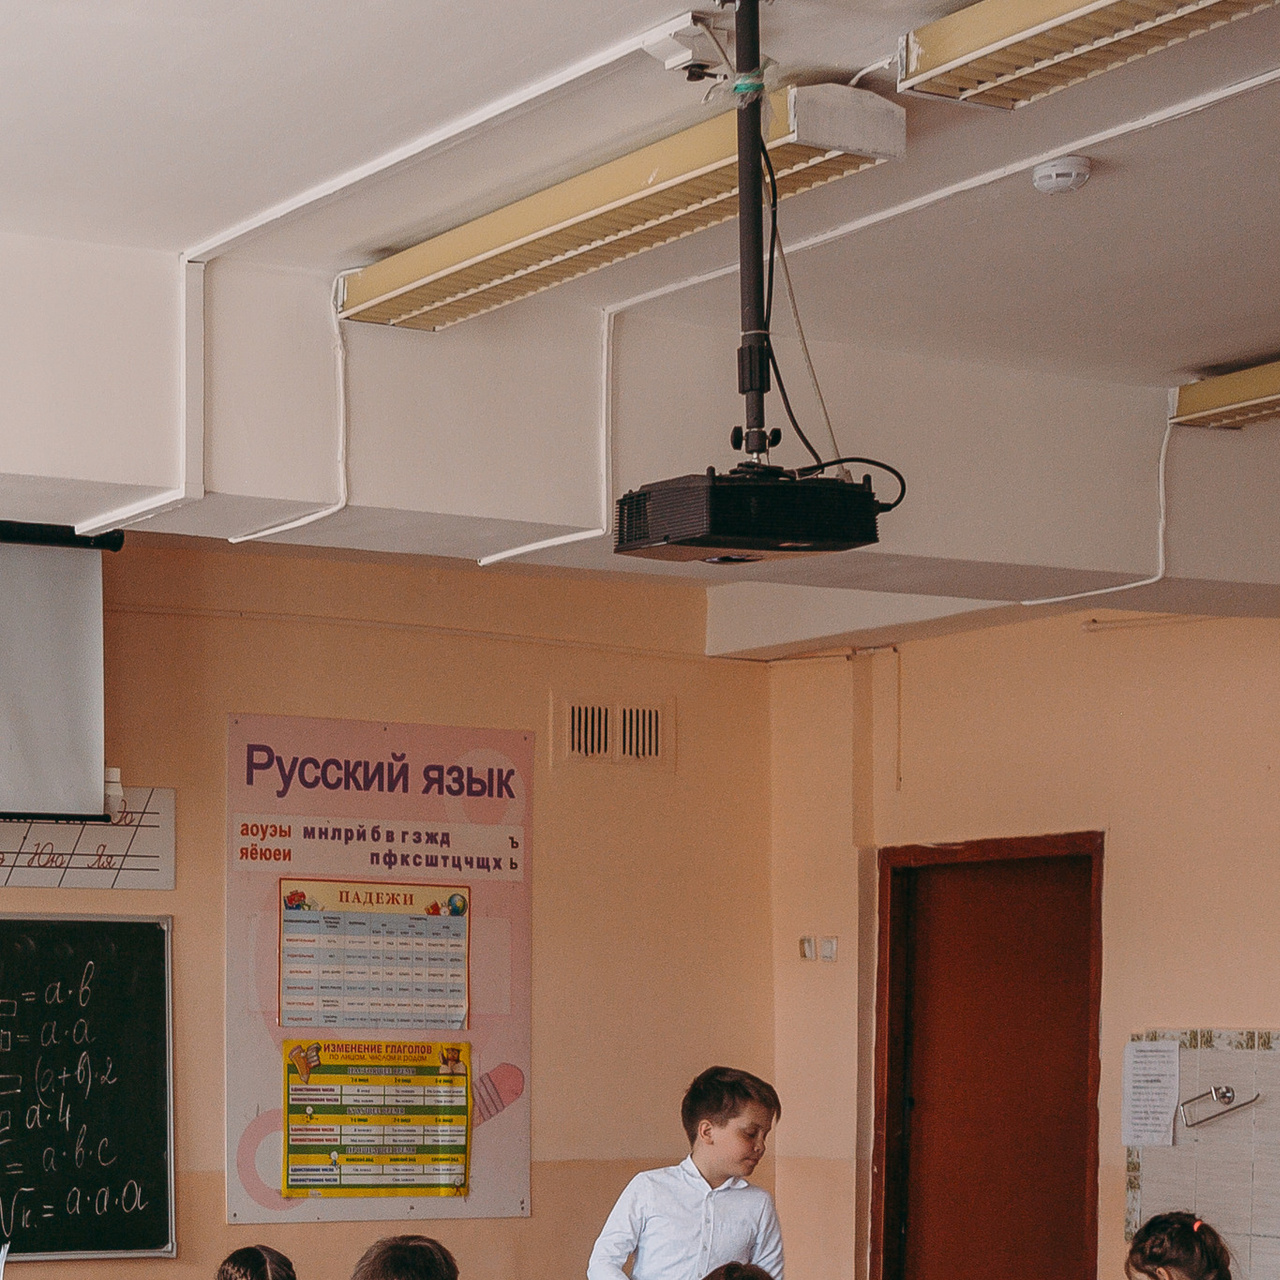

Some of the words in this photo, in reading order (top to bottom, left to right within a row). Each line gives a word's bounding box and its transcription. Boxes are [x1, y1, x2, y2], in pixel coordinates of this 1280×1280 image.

[246, 743, 409, 798] Русский
[422, 764, 515, 799] язык
[239, 845, 292, 862] яёюеи
[339, 890, 414, 906] ПАДЕЖИ
[323, 1043, 383, 1055] ИЗМЕНЕНИЕ
[385, 1044, 433, 1056] ГЛАГОЛОВ
